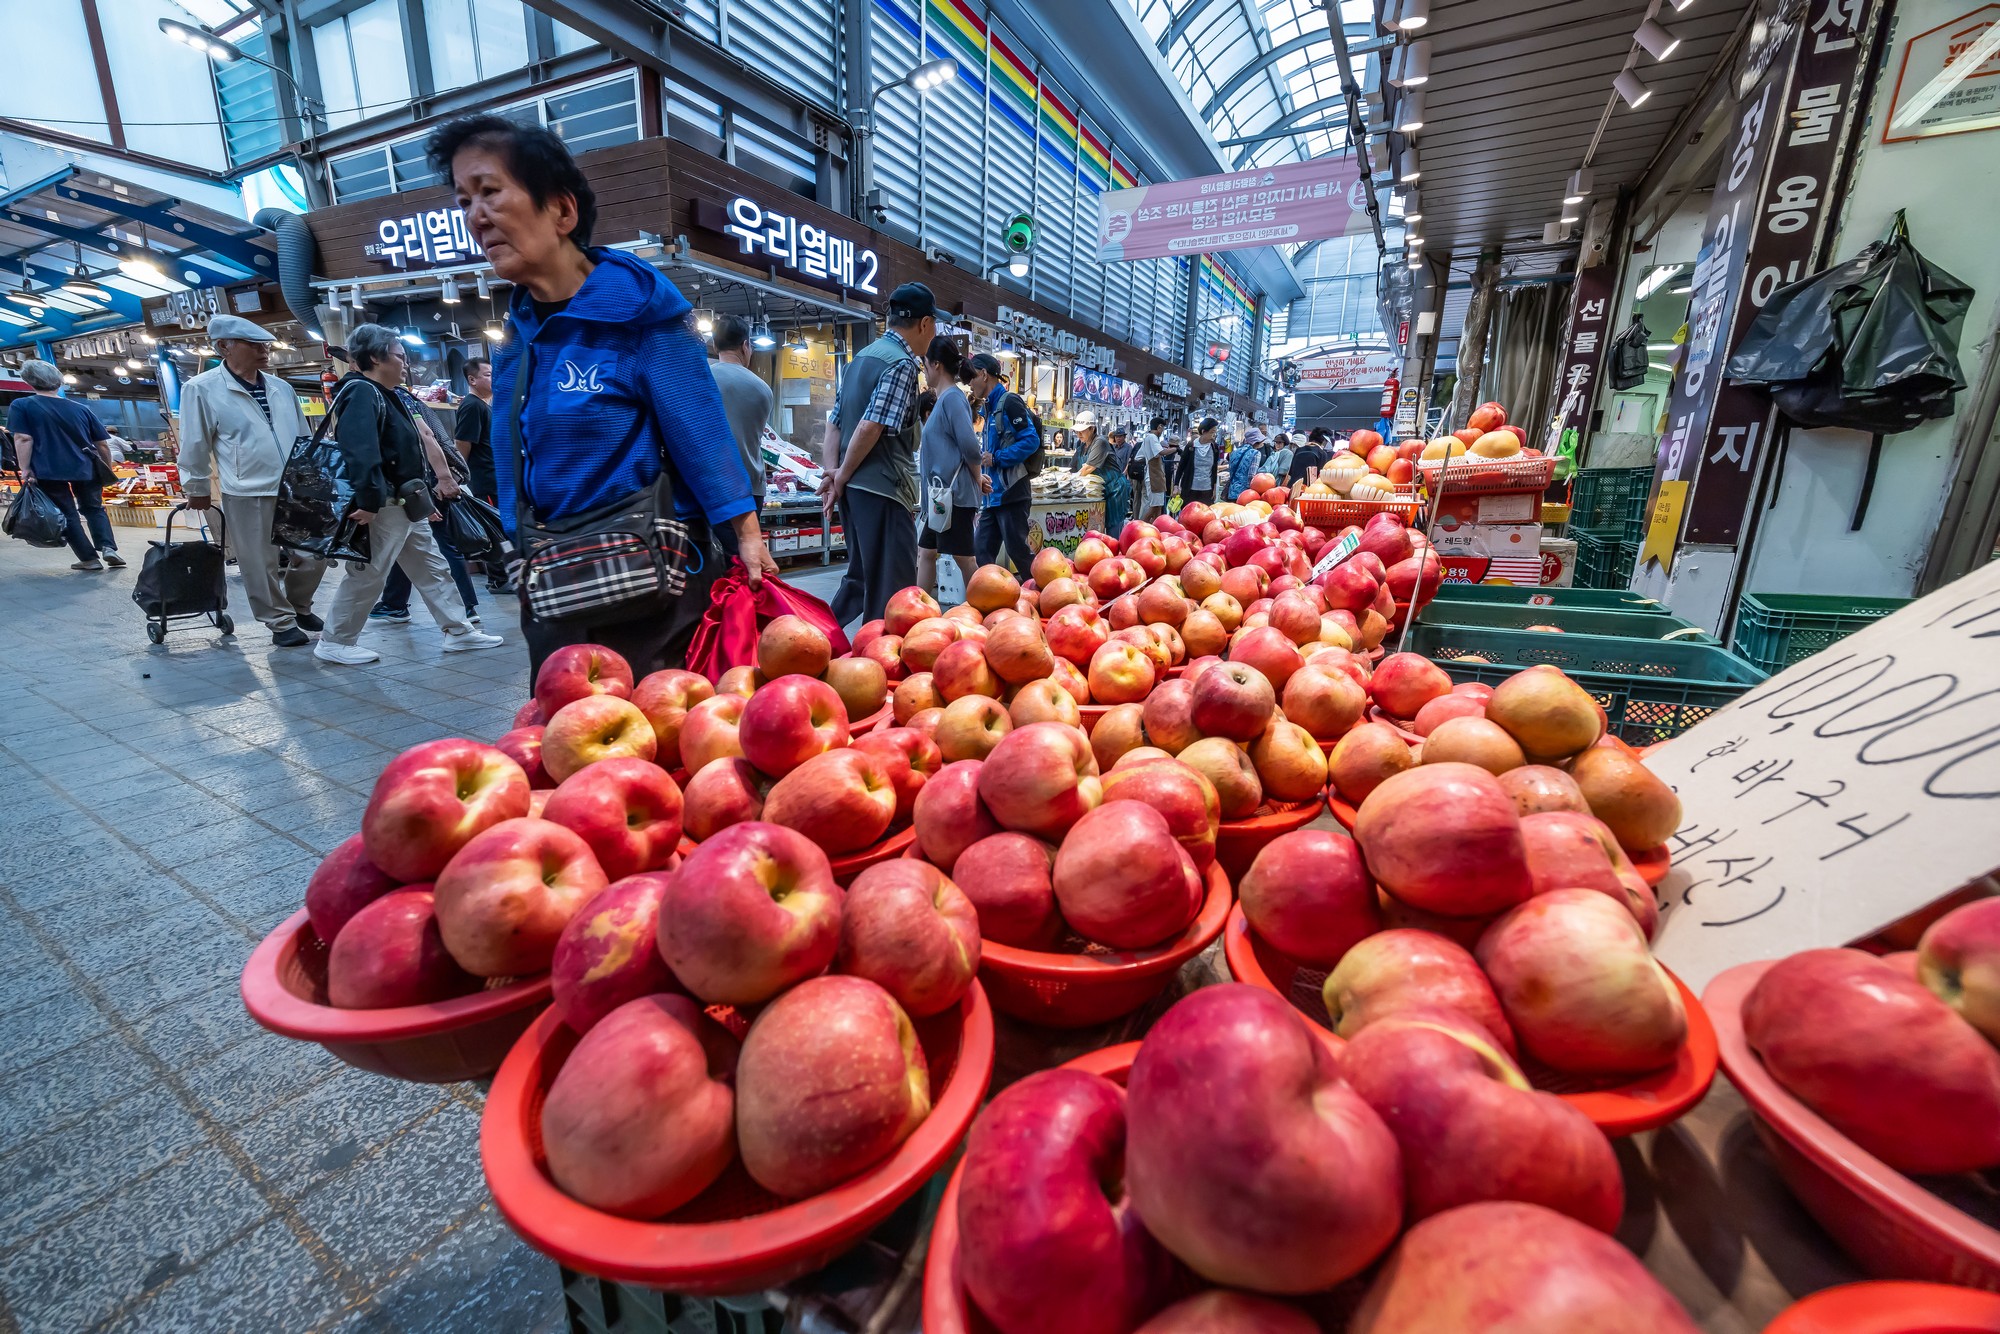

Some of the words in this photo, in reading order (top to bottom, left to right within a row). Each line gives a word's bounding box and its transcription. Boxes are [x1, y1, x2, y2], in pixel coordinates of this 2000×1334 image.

[725, 197, 855, 288] 우리열매
[857, 248, 879, 295] 2
[1661, 82, 1772, 481] 정일회
[1444, 537, 1472, 546] 레드향
[1448, 567, 1468, 578] 용암
